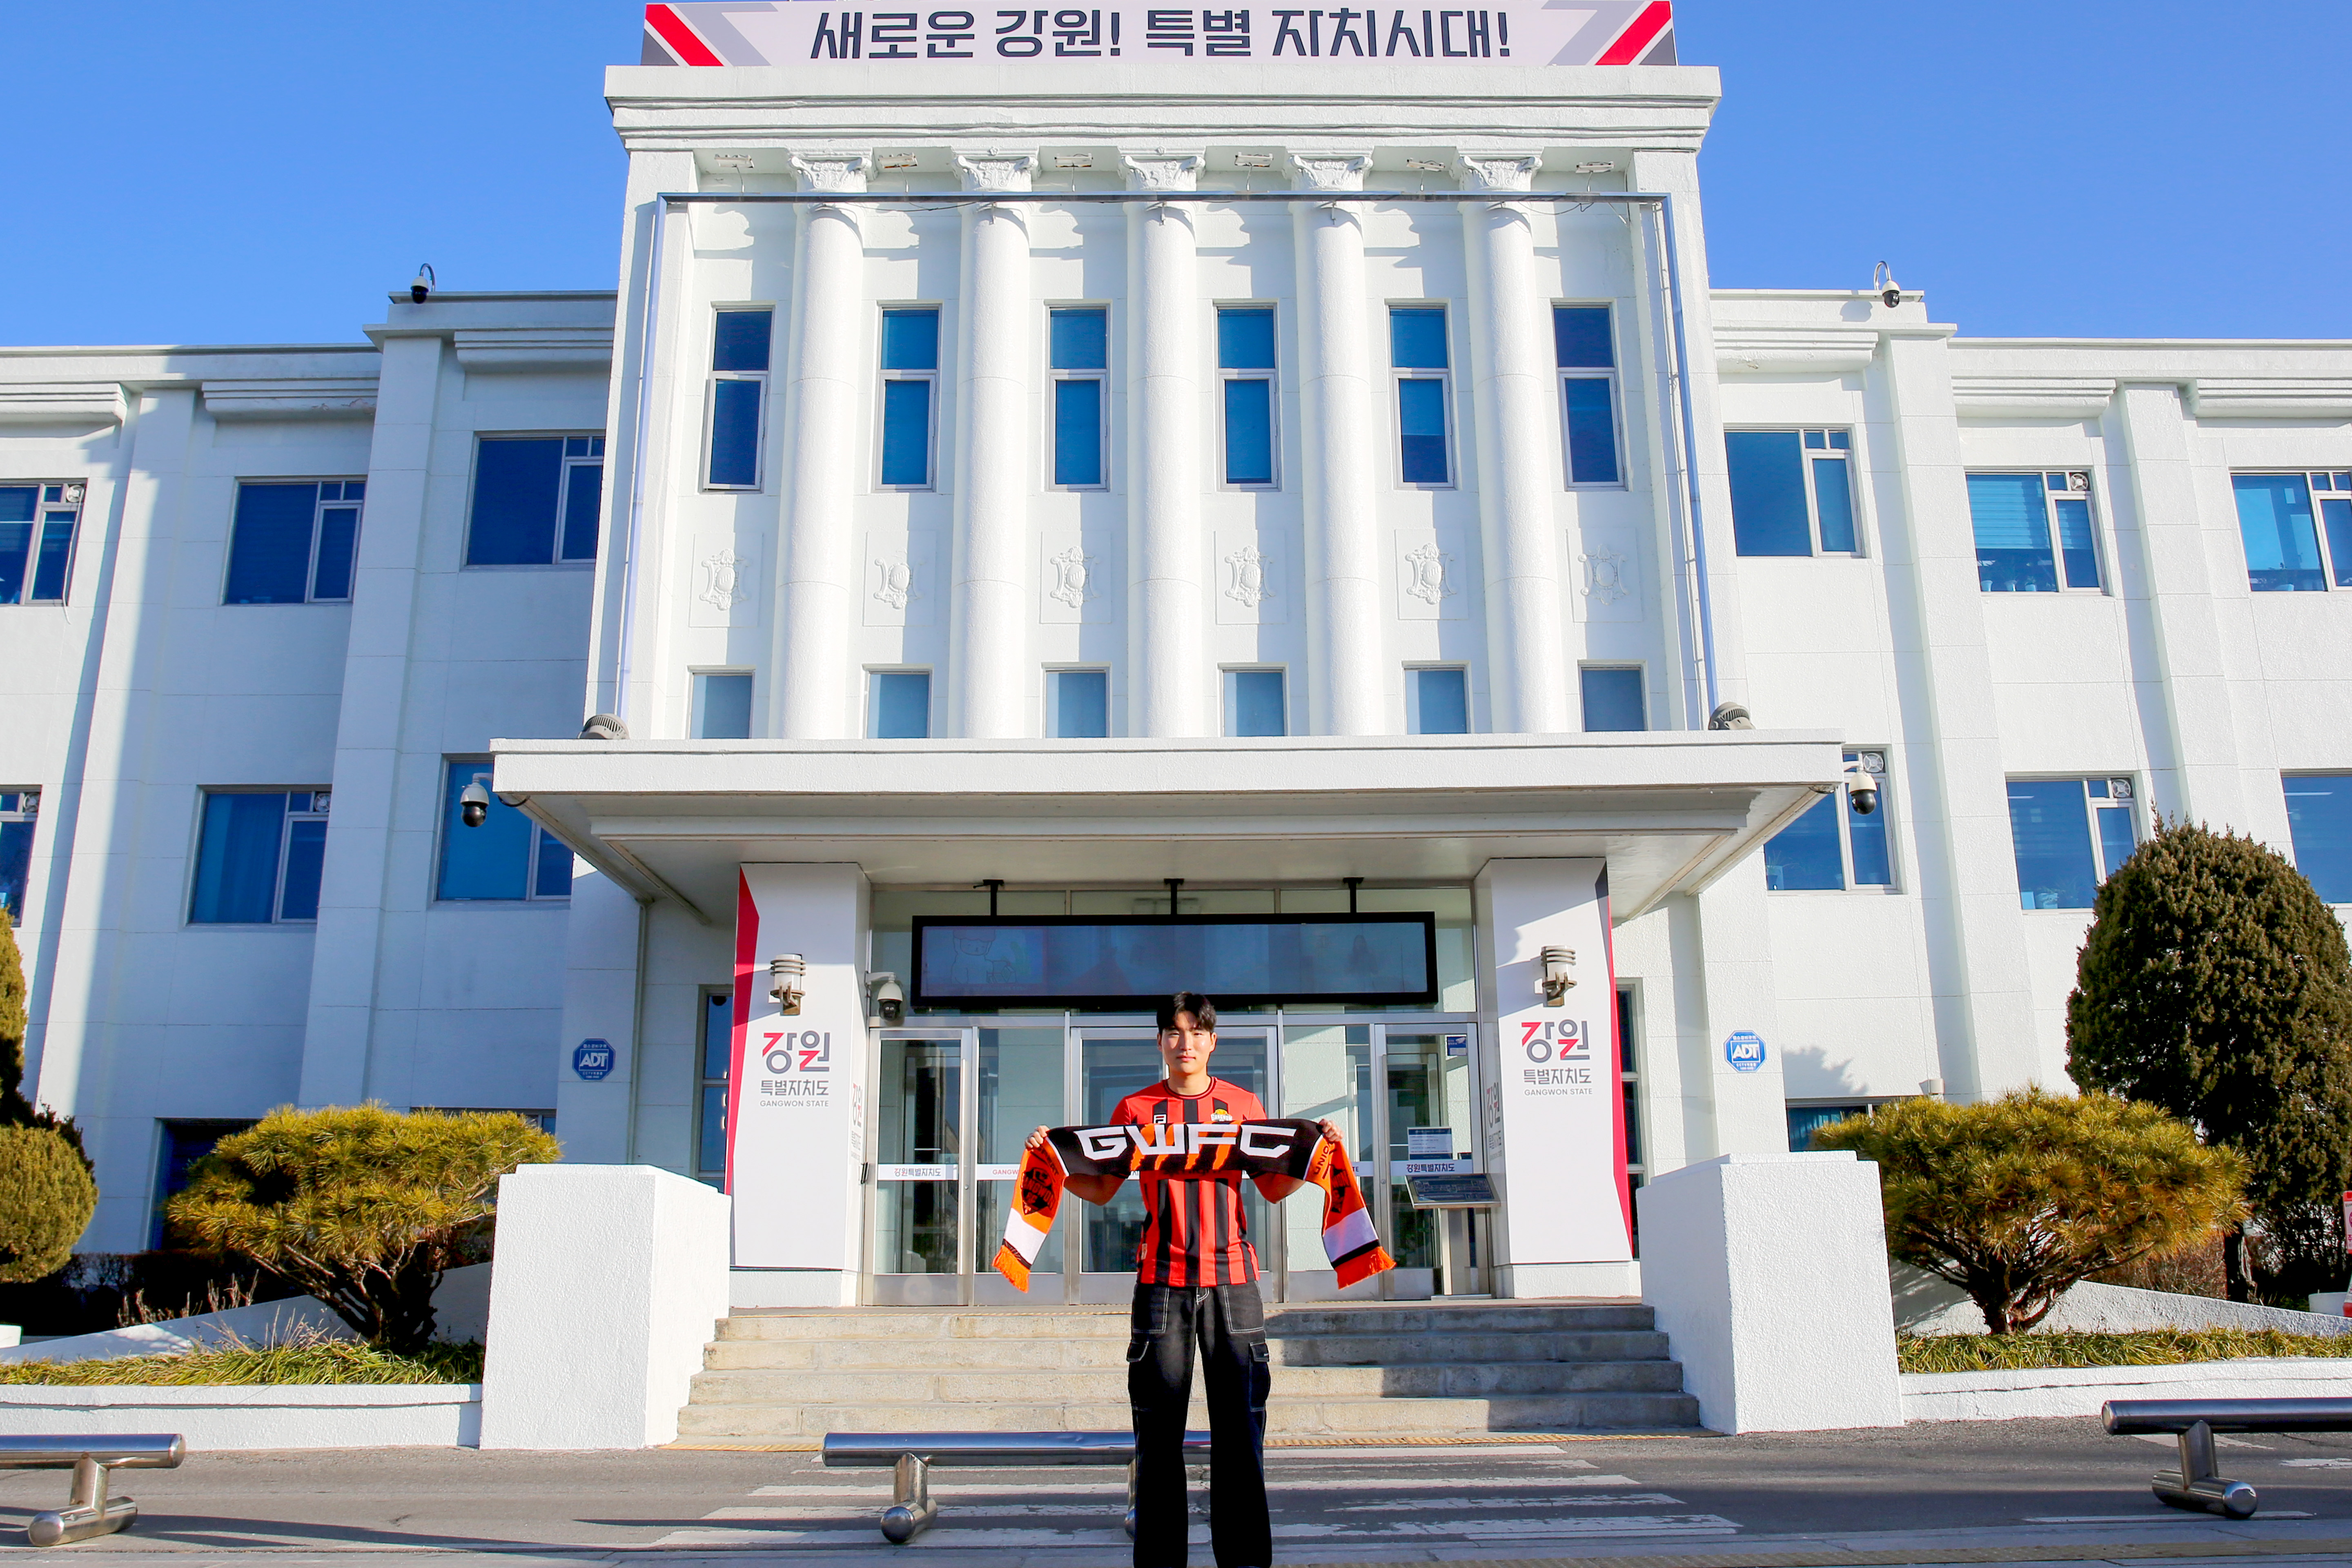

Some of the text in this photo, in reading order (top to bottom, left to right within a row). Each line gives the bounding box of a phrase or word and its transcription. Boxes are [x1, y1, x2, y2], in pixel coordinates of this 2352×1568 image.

[811, 8, 1510, 58] 새로운 강원! 특별 자치시대!
[1521, 1019, 1590, 1063] 강원
[579, 1053, 608, 1067] ADT
[762, 1030, 830, 1074] 강원
[1732, 1044, 1759, 1059] ADT
[1523, 1067, 1592, 1085] 특별자치도
[760, 1079, 829, 1096] 특별자치도
[1487, 1082, 1501, 1128] 강원
[1073, 1123, 1296, 1160] GWFC
[894, 1168, 941, 1176] 강원특별자치도
[1406, 1163, 1455, 1173] 강원특별자치도
